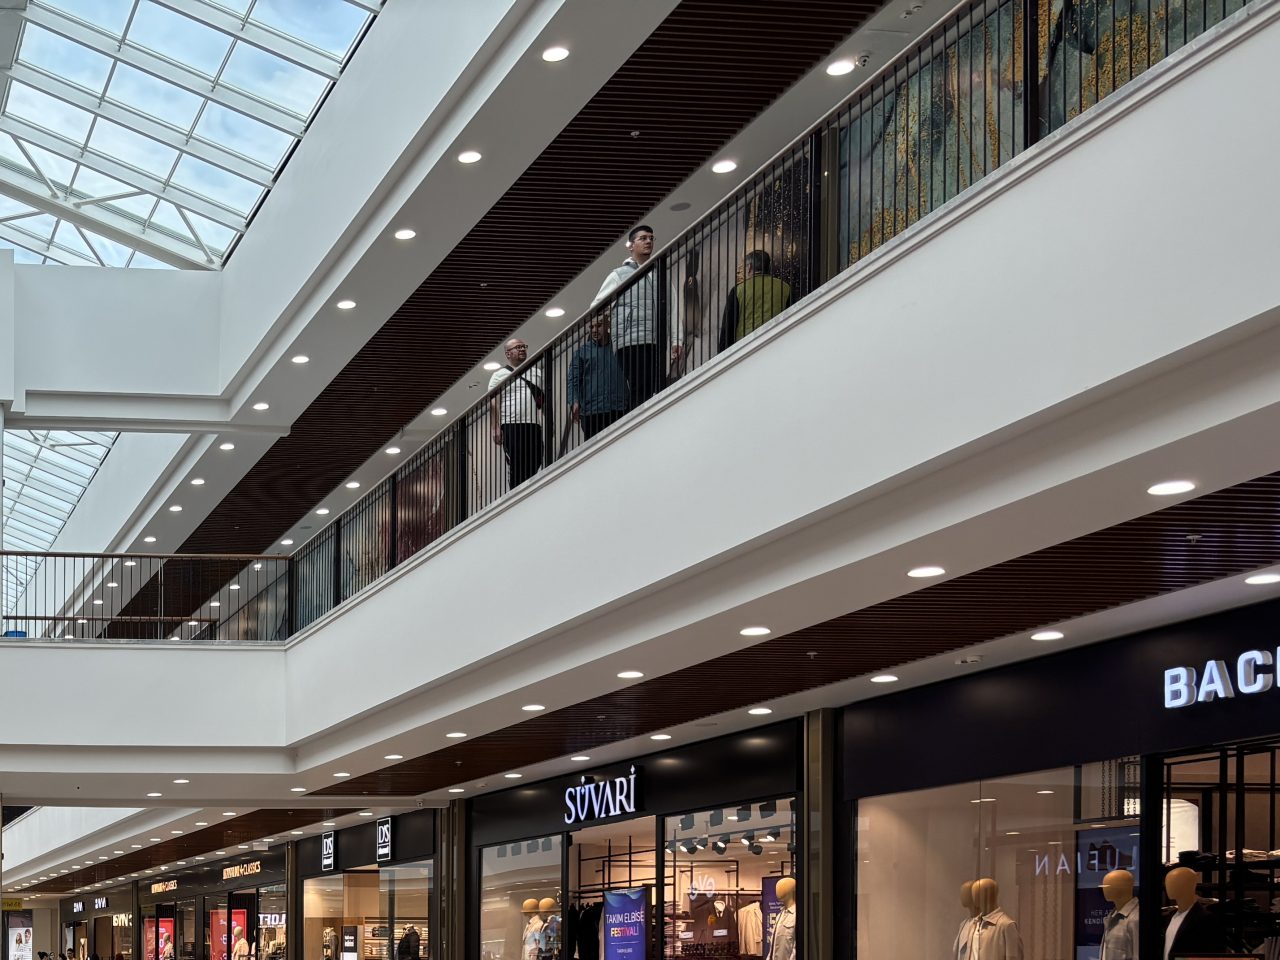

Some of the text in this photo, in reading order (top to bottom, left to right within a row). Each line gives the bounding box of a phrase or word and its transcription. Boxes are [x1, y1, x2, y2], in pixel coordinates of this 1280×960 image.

[564, 764, 636, 824] SÜVARİ
[606, 910, 645, 924] TAKIM ELBİSE
